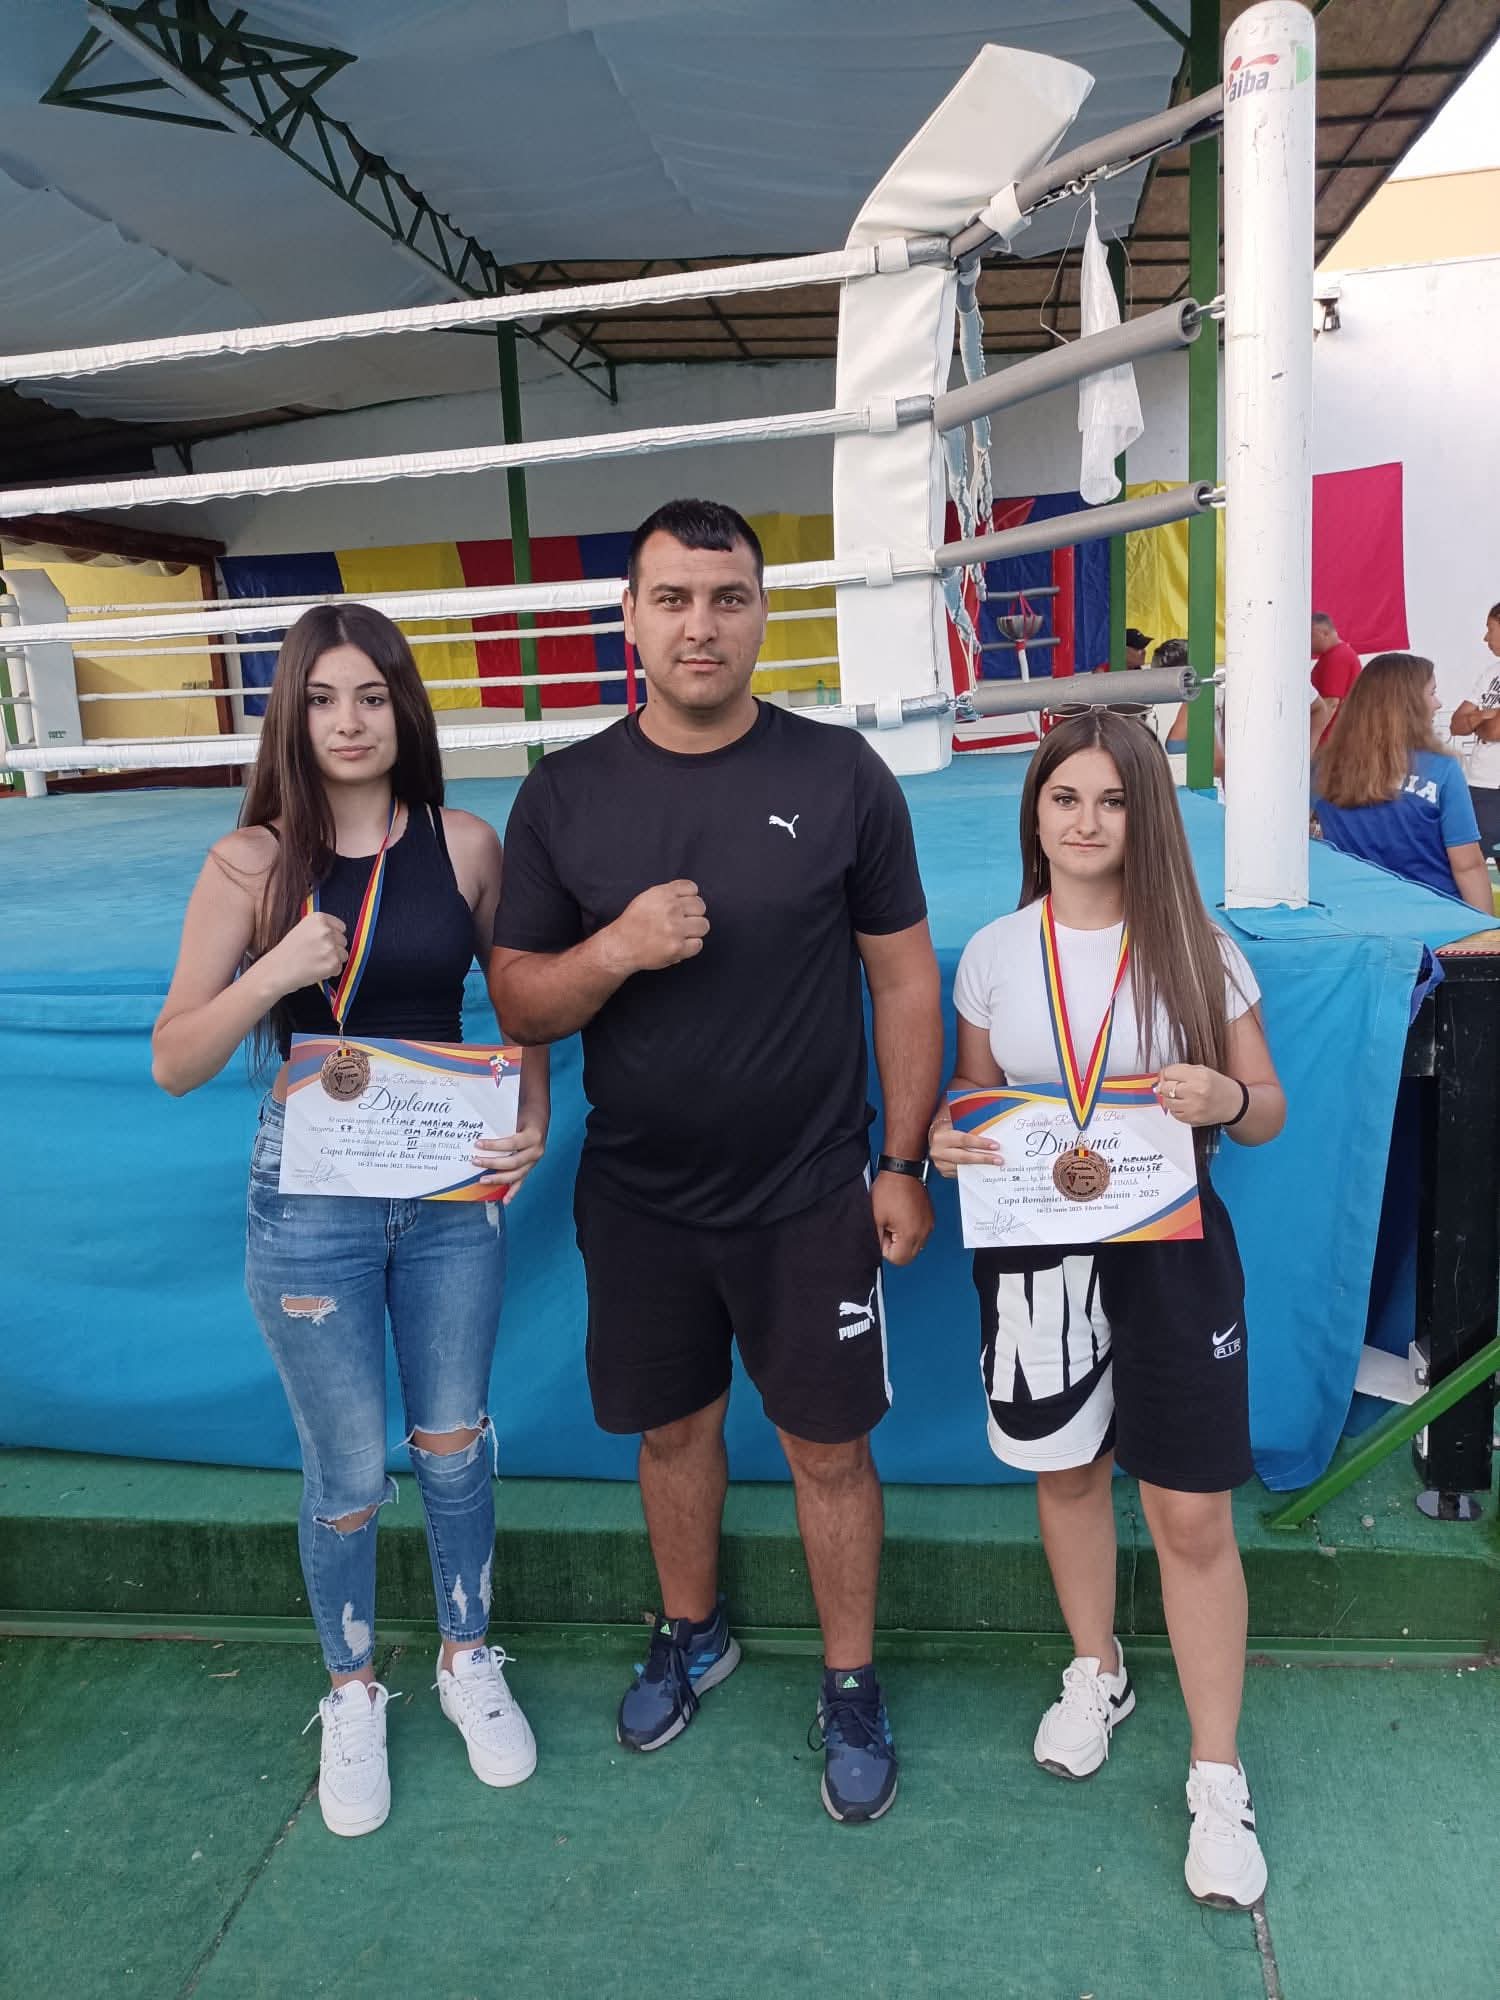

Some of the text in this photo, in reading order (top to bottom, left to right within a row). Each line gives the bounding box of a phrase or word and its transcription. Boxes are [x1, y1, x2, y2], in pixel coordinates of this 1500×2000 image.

[1229, 69, 1270, 102] aiba
[358, 1086, 453, 1118] Diplomă
[1138, 1188, 1160, 1198] 2025
[1216, 1339, 1240, 1357] AIR
